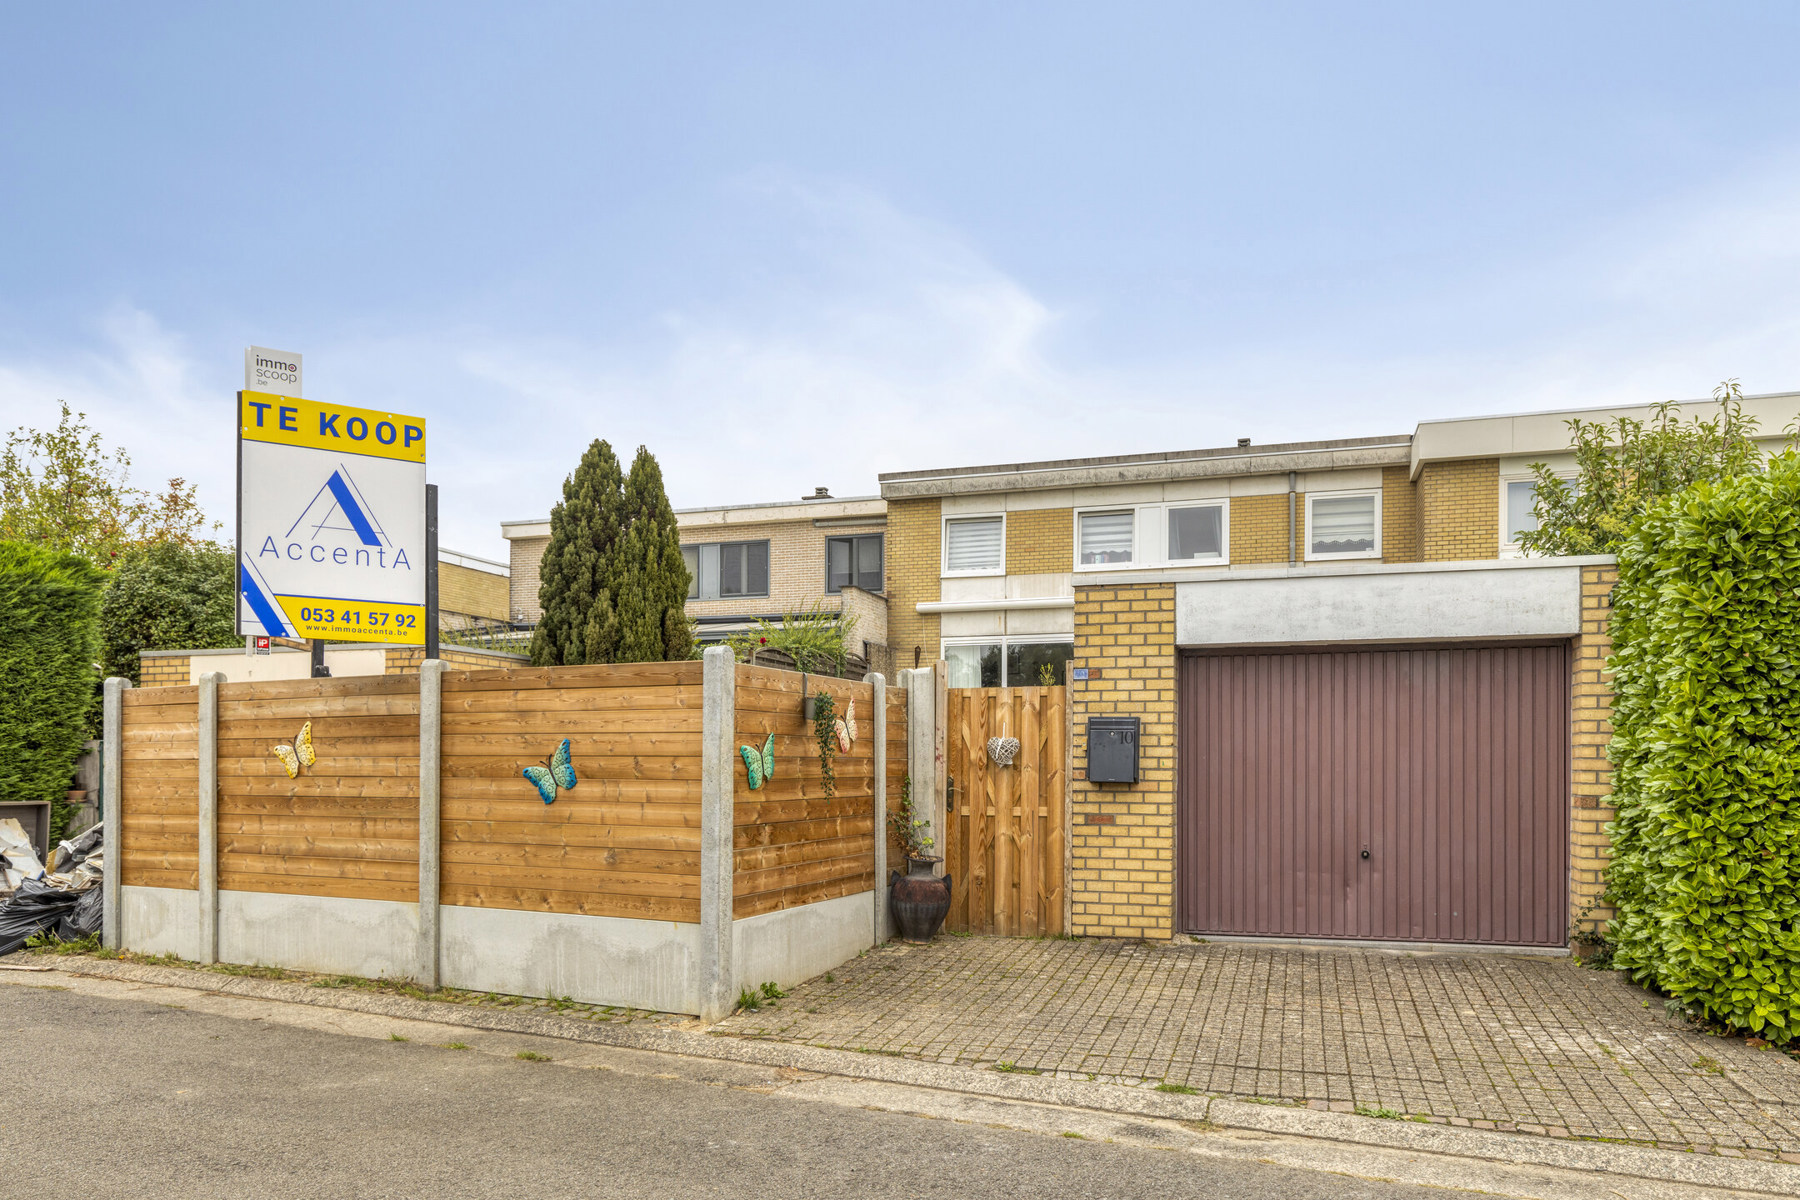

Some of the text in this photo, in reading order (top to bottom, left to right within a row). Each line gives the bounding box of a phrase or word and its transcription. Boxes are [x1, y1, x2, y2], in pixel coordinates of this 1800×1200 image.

[256, 354, 297, 372] immo
[256, 368, 297, 384] scoop
[249, 401, 423, 448] TE KOOP
[259, 535, 411, 570] AccentA
[301, 607, 416, 628] 053 41 57 92
[306, 624, 408, 636] www.immoaccenta.be
[1120, 731, 1134, 744] 10
